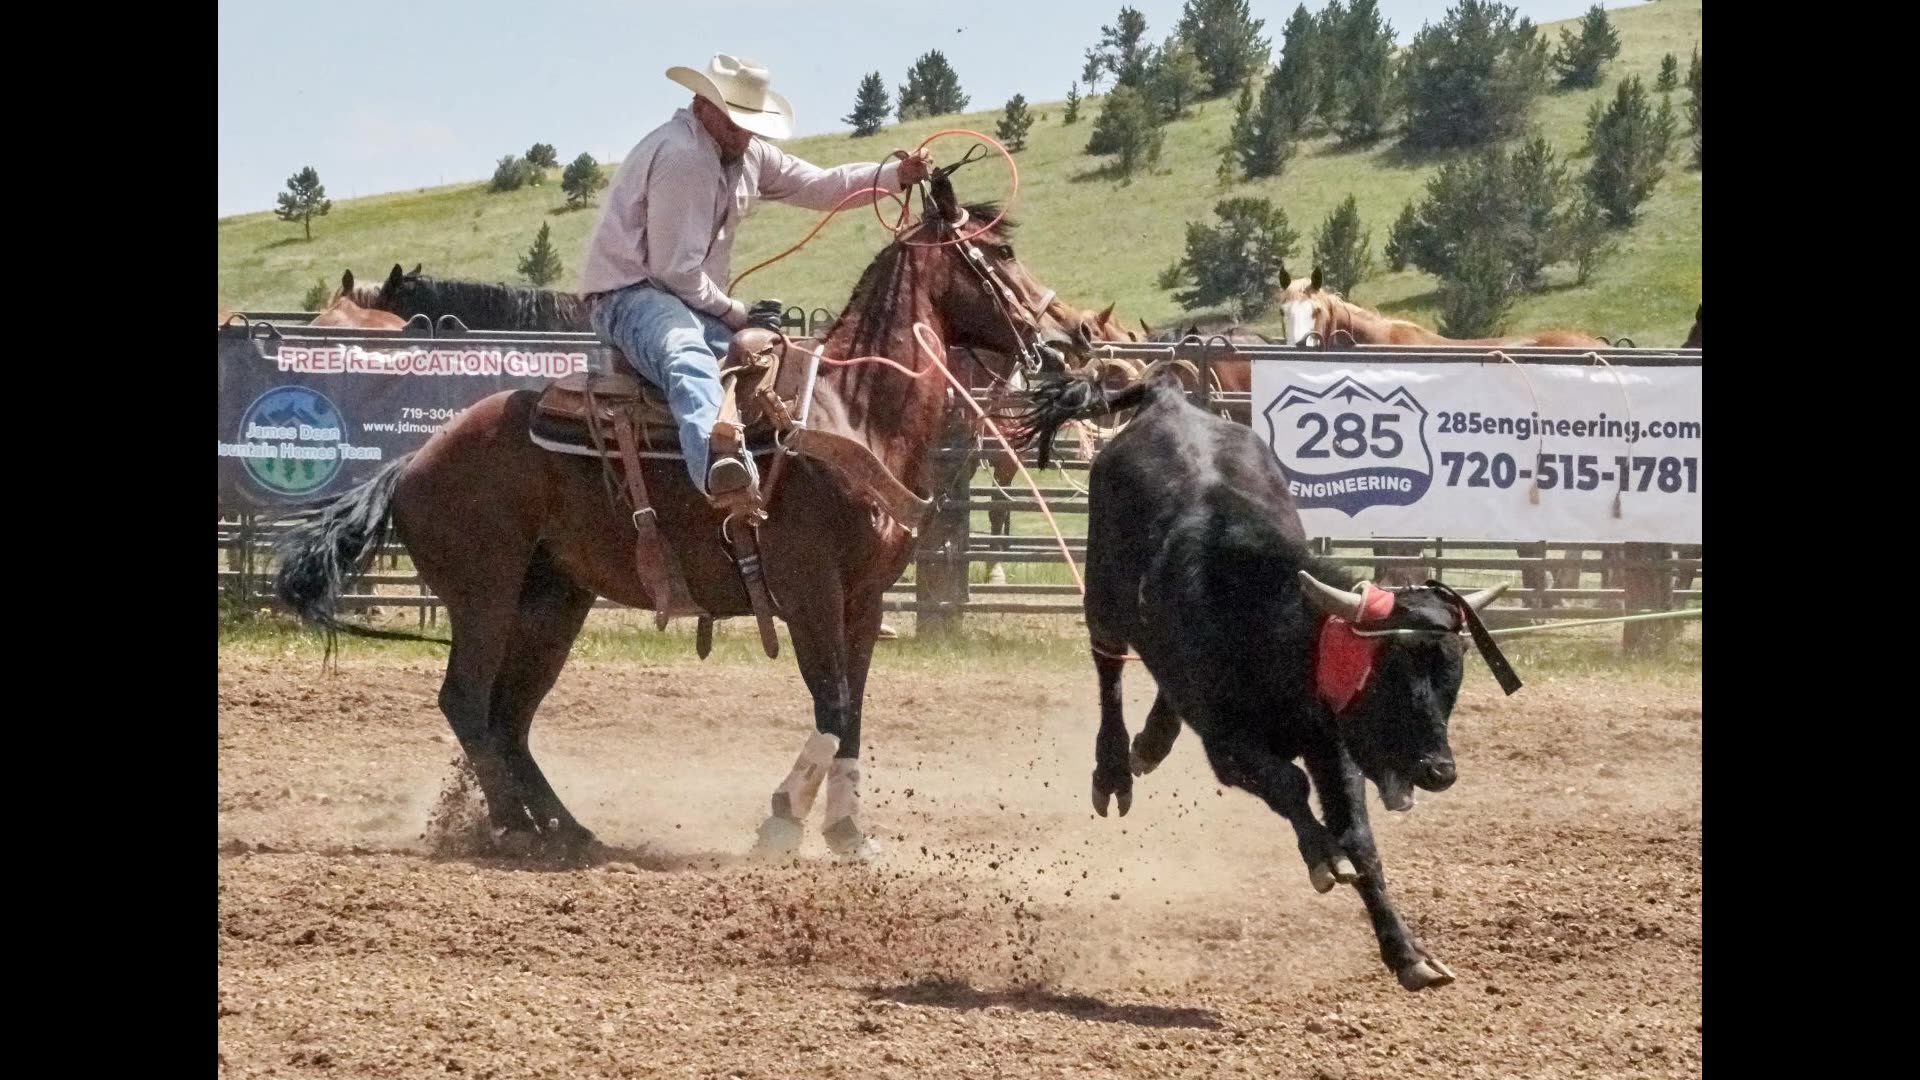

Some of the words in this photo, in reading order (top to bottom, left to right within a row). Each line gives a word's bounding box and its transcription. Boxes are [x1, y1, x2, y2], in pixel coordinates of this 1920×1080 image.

[278, 347, 343, 372] FREE
[346, 346, 500, 375] RELOCATION
[503, 350, 588, 378] GUIDE
[402, 407, 466, 420] 719-304-
[246, 422, 297, 439] James
[300, 424, 340, 440] Dean
[363, 421, 443, 434] www.jdmoun
[1295, 412, 1404, 459] 285
[1437, 411, 1701, 443] 285engineering.com
[218, 440, 277, 458] ountain
[280, 442, 336, 459] Homes
[337, 443, 382, 460] Team
[1441, 451, 1698, 493] 720-515-1781
[1288, 475, 1412, 498] ENGINEERING
